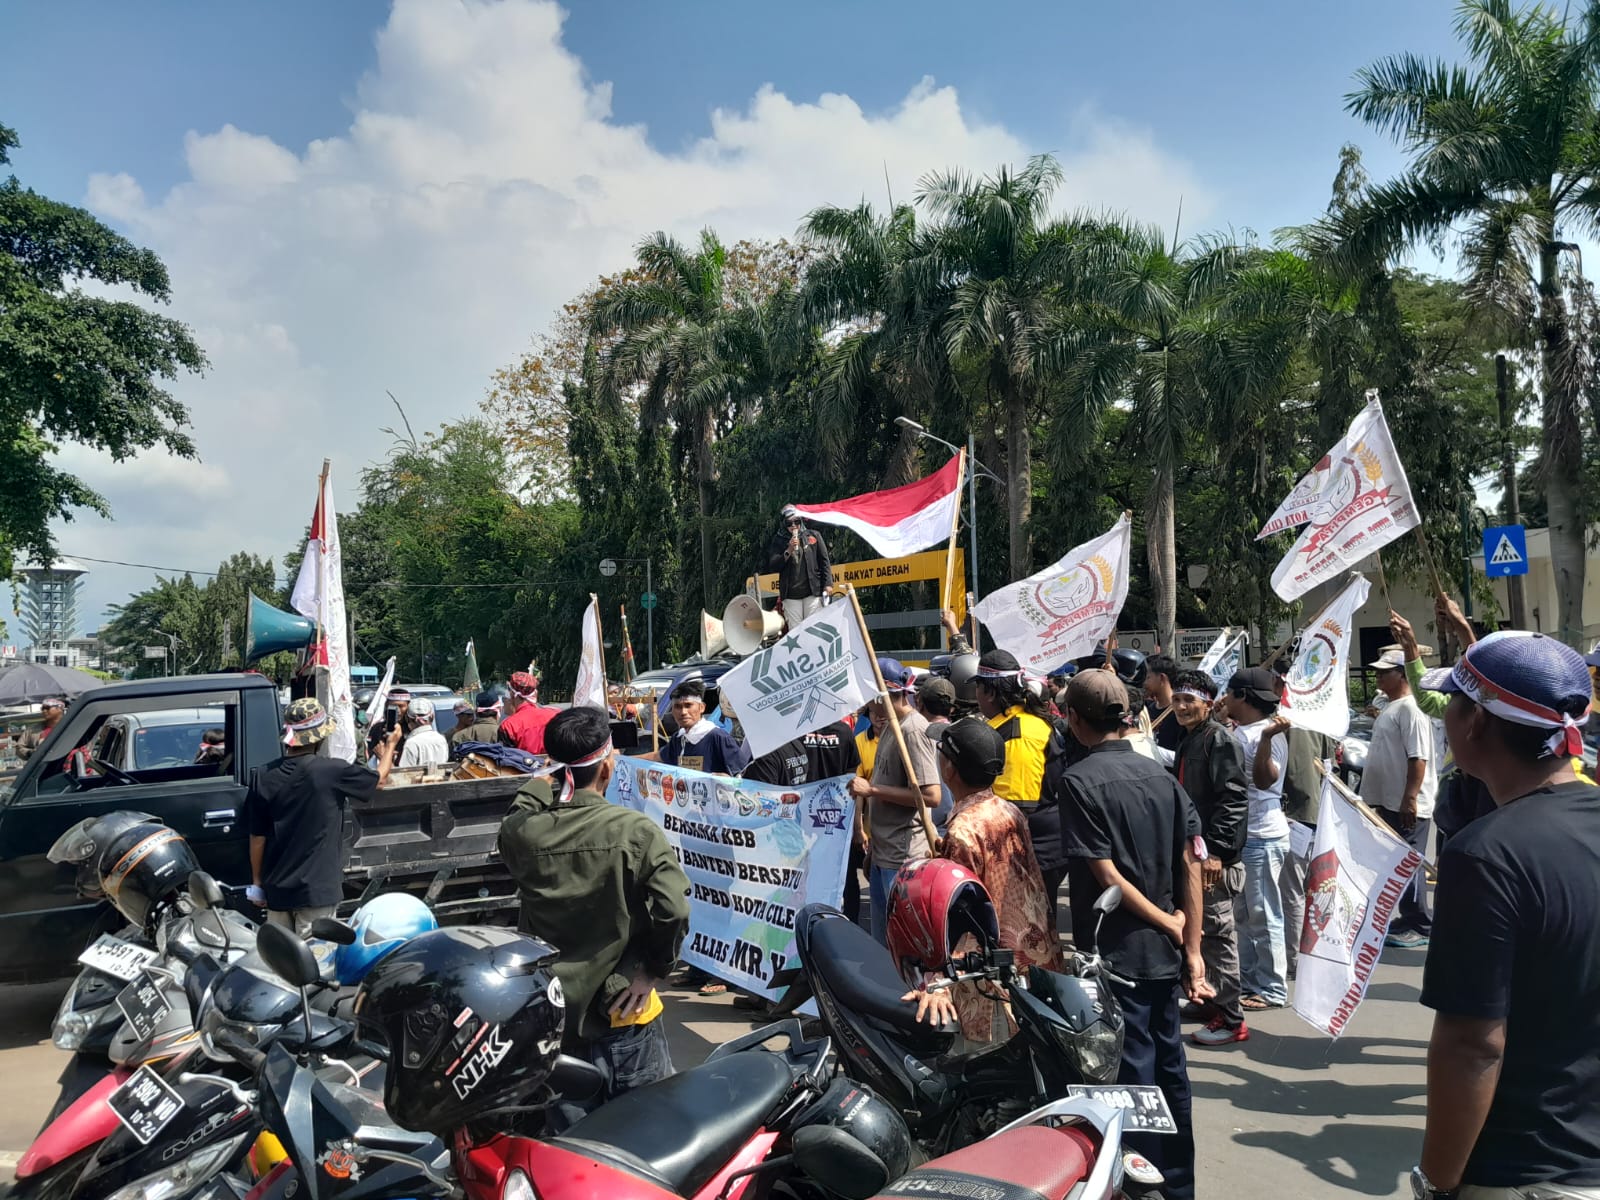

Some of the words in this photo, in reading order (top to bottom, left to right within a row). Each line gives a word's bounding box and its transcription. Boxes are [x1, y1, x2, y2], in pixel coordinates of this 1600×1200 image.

[844, 567, 873, 581] RAKYAT
[876, 563, 910, 578] DAERAH
[664, 813, 719, 844] BERSAMA
[721, 825, 756, 848] KBB
[684, 851, 735, 878] BANTEN
[738, 862, 803, 890] BERSATU
[694, 883, 730, 908] APBD
[732, 894, 764, 920] KOTA
[690, 932, 731, 963] ALIAS
[729, 939, 768, 981] MR.
